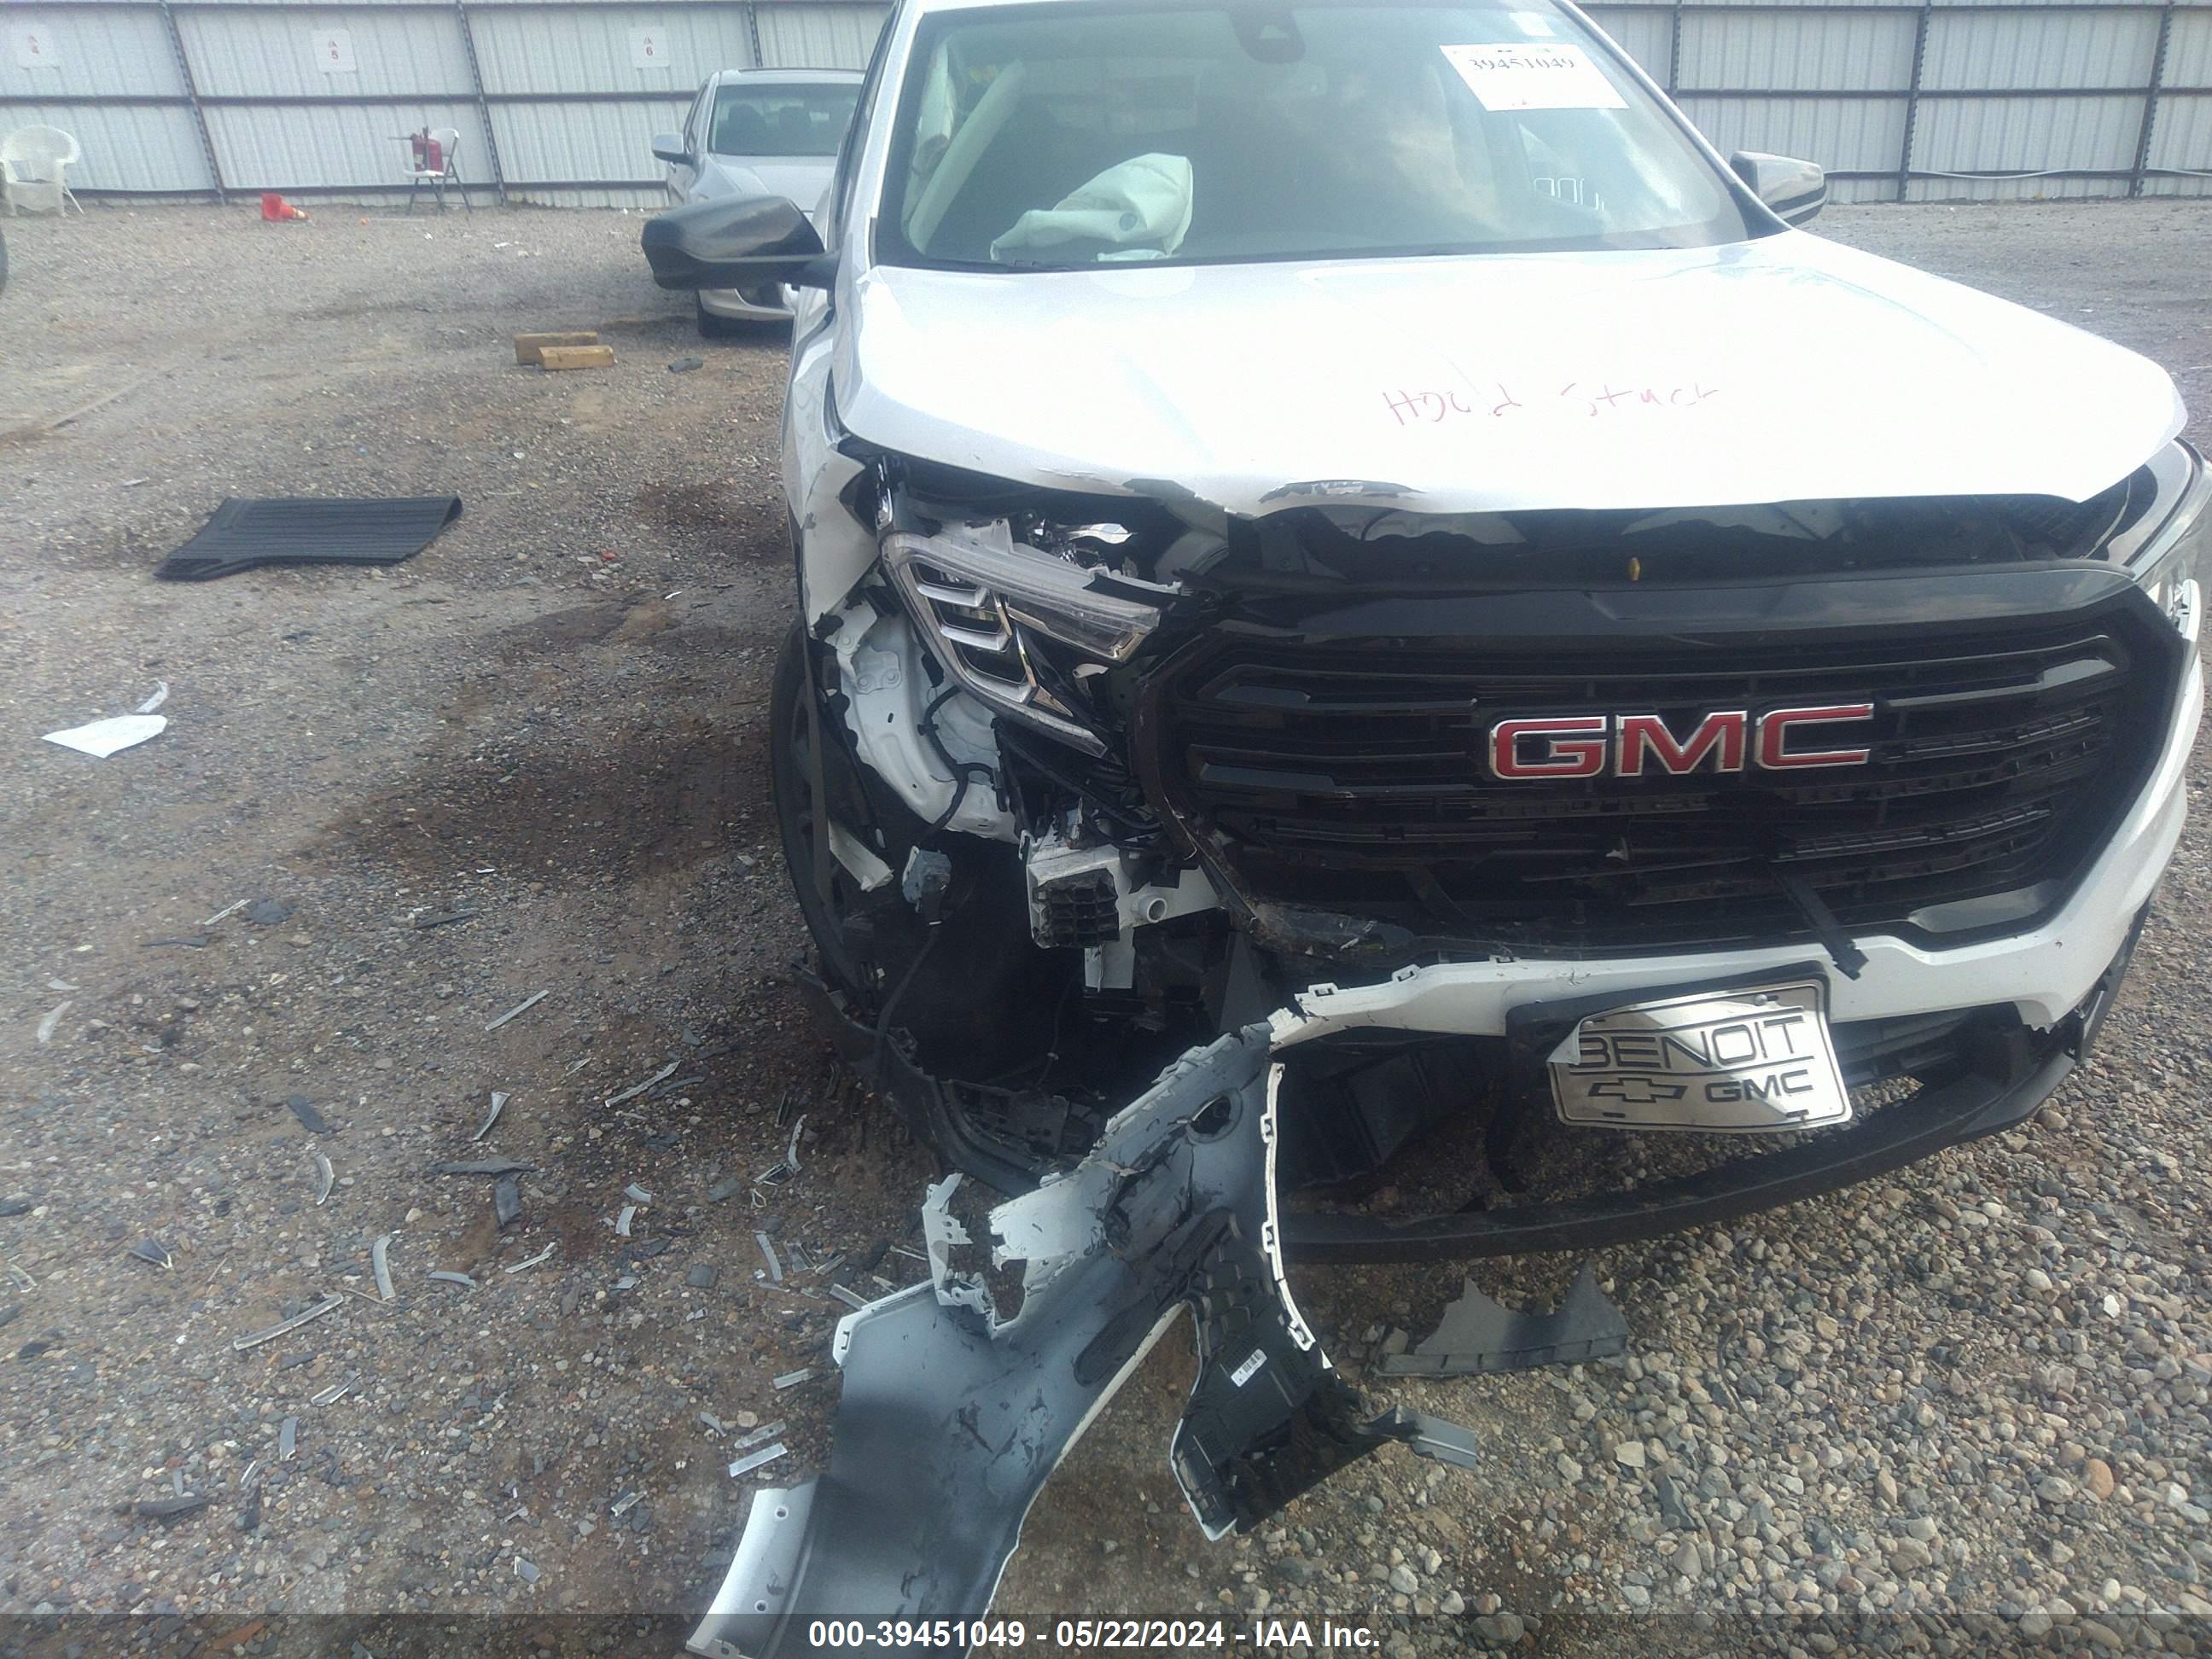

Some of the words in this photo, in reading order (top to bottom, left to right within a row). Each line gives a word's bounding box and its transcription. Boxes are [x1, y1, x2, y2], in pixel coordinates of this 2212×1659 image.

[331, 50, 339, 60] 5
[646, 47, 654, 55] 6
[1488, 704, 1874, 779] GMC
[1569, 1016, 1803, 1069] BENOIT
[1705, 1069, 1813, 1103] GMC
